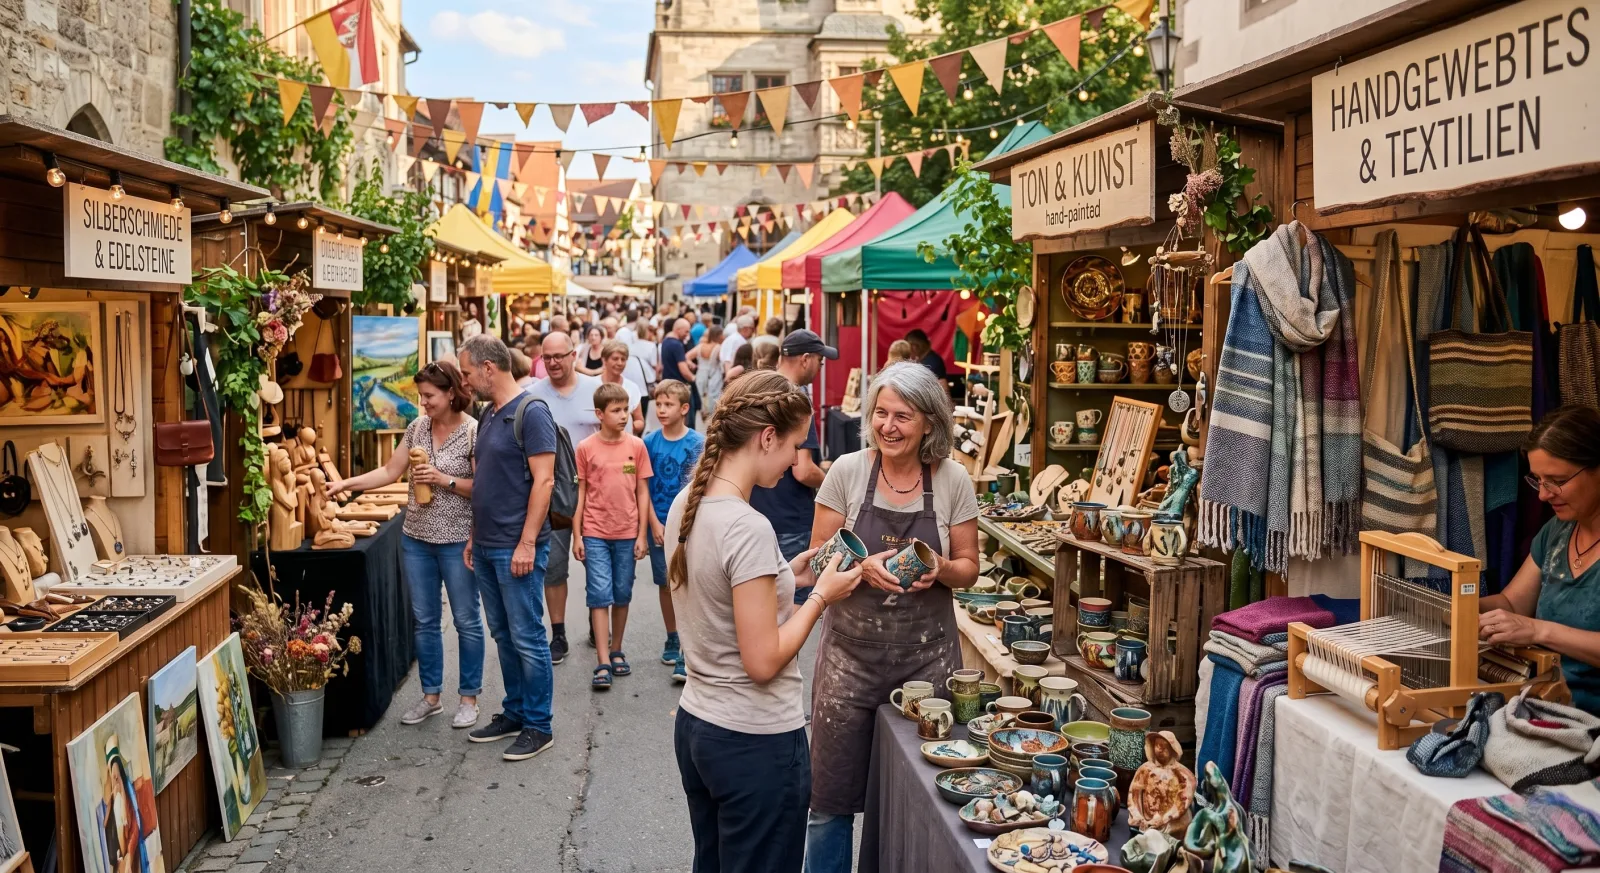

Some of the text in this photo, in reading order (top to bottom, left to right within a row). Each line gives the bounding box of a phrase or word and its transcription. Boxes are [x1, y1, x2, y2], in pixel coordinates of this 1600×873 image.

[1331, 7, 1590, 132] HANDGEWEBTES
[1019, 138, 1138, 209] TON & KUNST
[1359, 96, 1541, 184] & TEXTILIEN
[83, 198, 183, 242] SILBERSCHMIEDE
[95, 239, 175, 275] & EDELSTEINE
